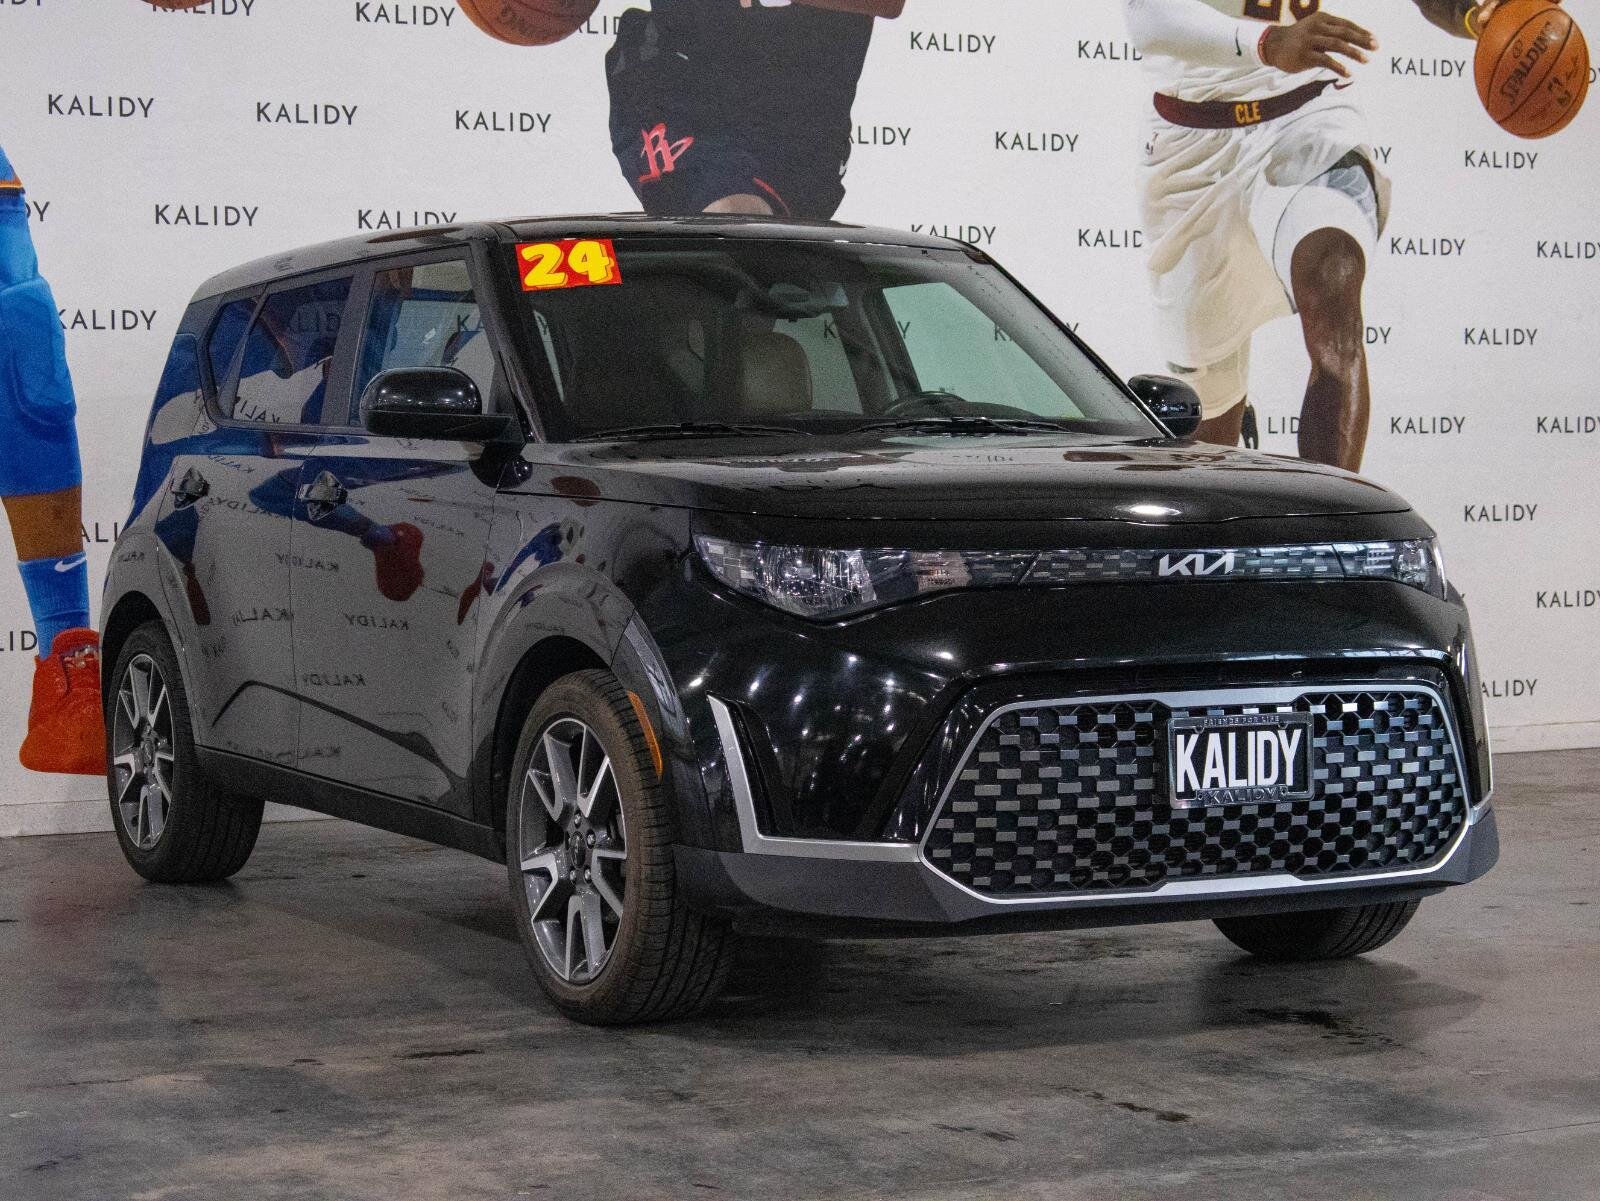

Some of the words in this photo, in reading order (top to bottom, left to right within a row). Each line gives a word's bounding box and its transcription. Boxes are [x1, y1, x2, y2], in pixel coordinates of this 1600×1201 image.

[356, 2, 456, 27] KALIDY
[910, 31, 996, 53] KALIDY
[1078, 40, 1143, 61] KALID
[1391, 56, 1466, 77] KALIDY
[48, 94, 154, 118] KALIDY
[256, 102, 358, 125] KALIDY
[1234, 102, 1262, 125] CLE
[455, 110, 551, 133] KALIDY
[848, 126, 911, 147] LIDY
[995, 131, 1079, 152] KALIDY
[1465, 150, 1538, 170] KALIDY
[155, 204, 258, 226] KALIDY
[1078, 228, 1142, 248] KALID
[1391, 237, 1465, 256] KALIDY
[1537, 241, 1600, 259] KALID
[519, 238, 613, 288] 24
[1465, 327, 1538, 345] KALIDY
[1391, 416, 1465, 434] KALIDY
[1537, 416, 1600, 434] KALID
[1464, 504, 1538, 522] KALIDY
[1158, 552, 1235, 577] KIA
[1537, 590, 1600, 609] KALID
[1481, 679, 1538, 698] ALIDY
[1176, 729, 1302, 793] KALIDY
[1206, 787, 1277, 804] KALIDY
